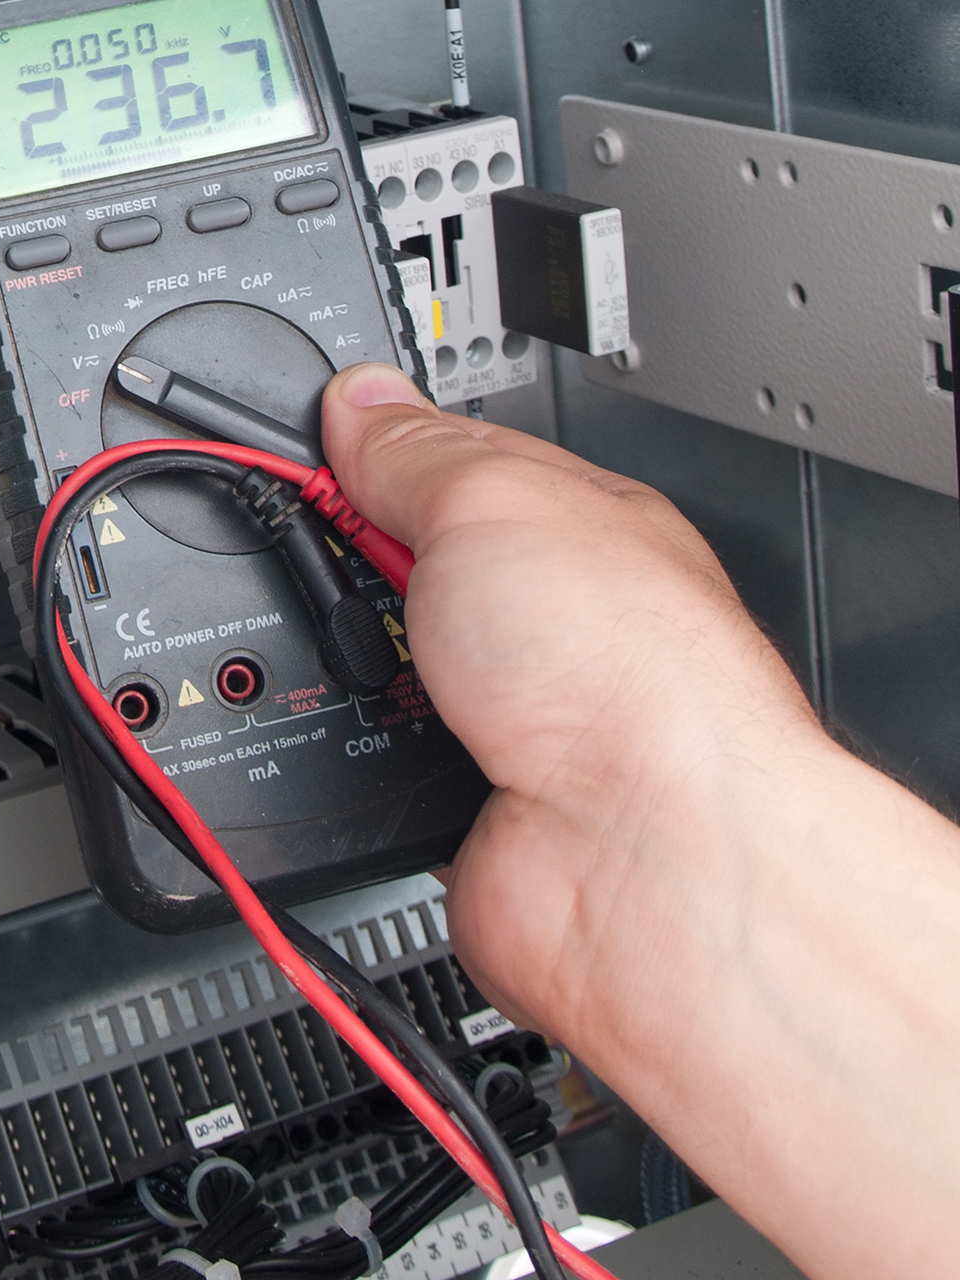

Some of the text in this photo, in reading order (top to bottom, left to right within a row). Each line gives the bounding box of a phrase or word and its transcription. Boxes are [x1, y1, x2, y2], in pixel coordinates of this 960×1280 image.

[219, 24, 231, 39] V
[19, 22, 190, 77] FREQ 0.050 kHz
[16, 37, 277, 160] 236.7
[448, 145, 477, 160] 43 NO
[493, 139, 505, 152] A1
[374, 160, 404, 177] 21 NC
[412, 152, 441, 169] 33 NO
[273, 164, 314, 183] DC/AC
[202, 183, 222, 198] UP
[85, 196, 158, 222] SET/RESET
[5, 265, 84, 293] PWR RESET
[146, 273, 190, 294] FREQ
[198, 266, 228, 284] hFE
[241, 272, 274, 291] CAP
[480, 368, 495, 381] NO
[511, 361, 523, 374] A2
[58, 389, 91, 408] OFF
[123, 612, 283, 661] AUTO POWER OFF DMM
[287, 683, 328, 701] 400mA
[398, 695, 427, 709] MAX
[180, 731, 222, 751] FUSED
[181, 756, 217, 774] 30sec
[219, 750, 235, 764] on
[236, 741, 271, 760] EACH
[273, 733, 309, 751] 15min
[310, 727, 327, 741] off
[344, 732, 391, 757] COM
[247, 761, 281, 783] mA
